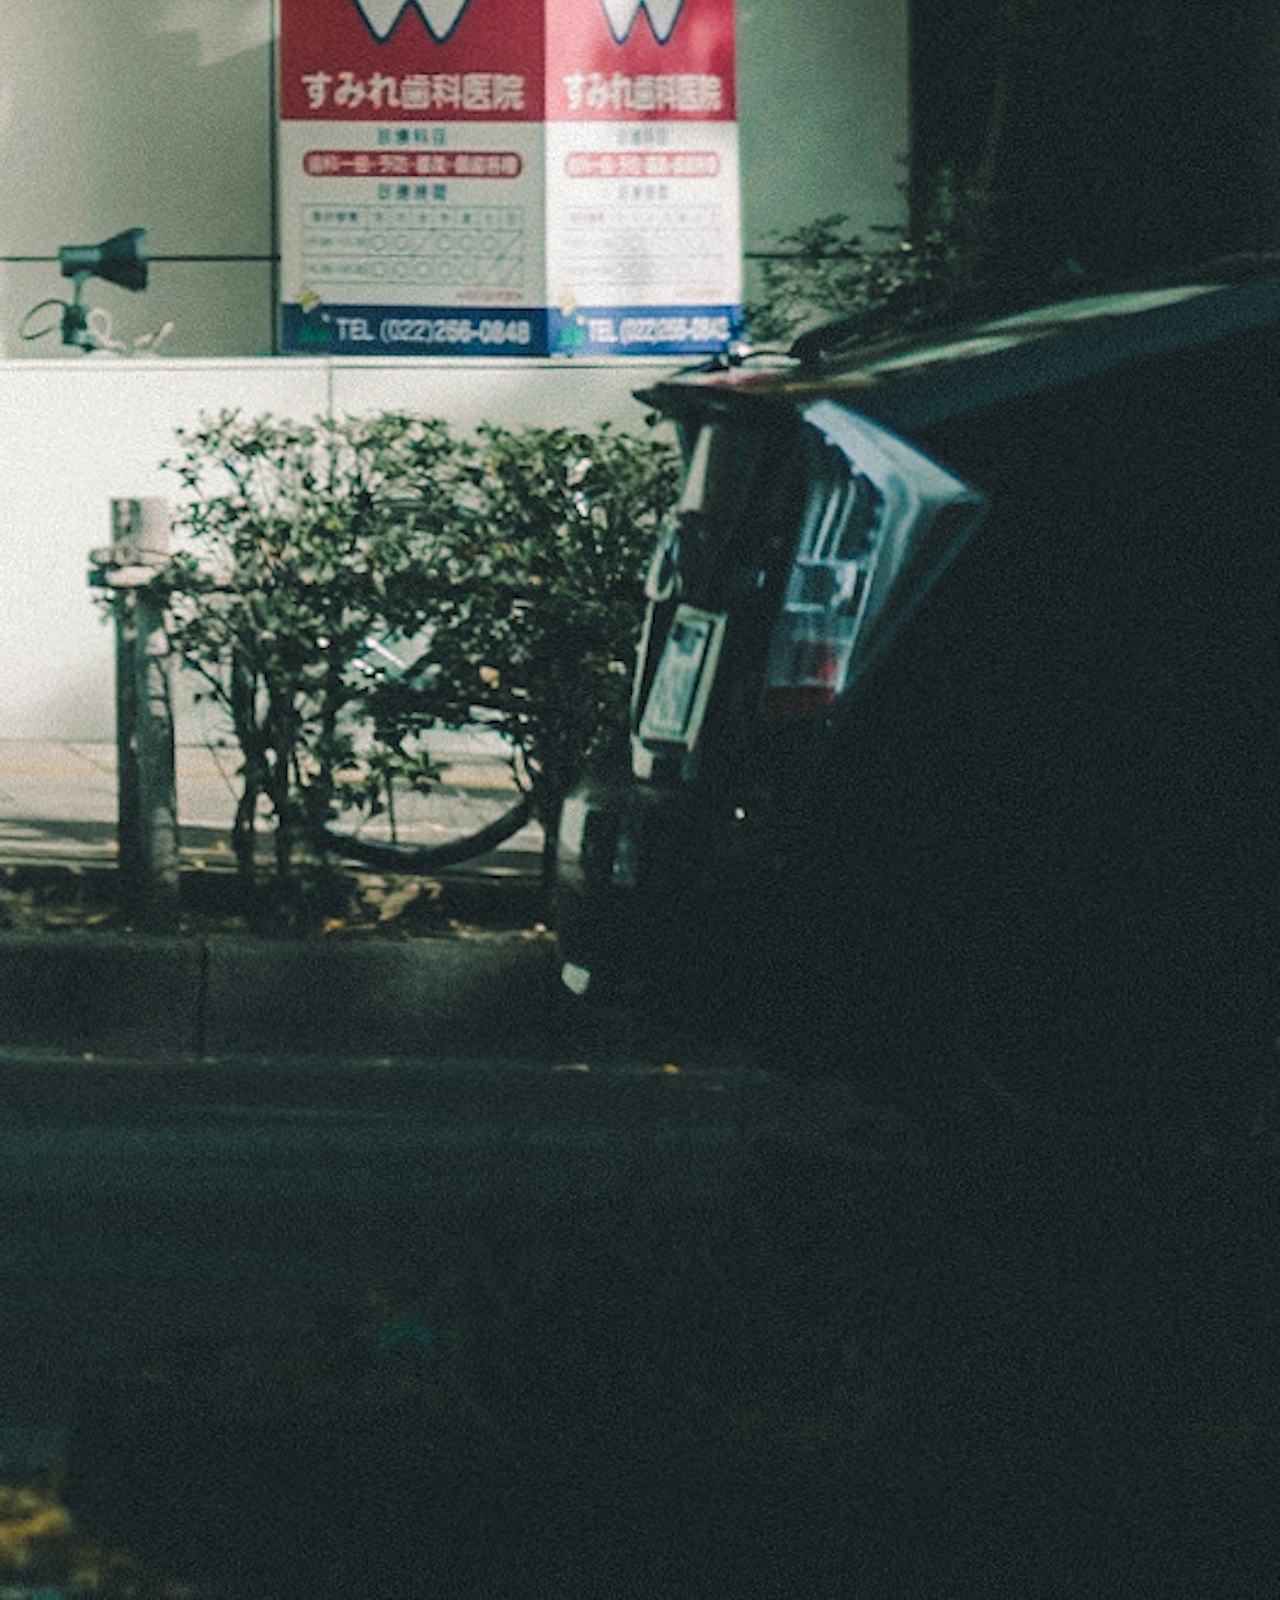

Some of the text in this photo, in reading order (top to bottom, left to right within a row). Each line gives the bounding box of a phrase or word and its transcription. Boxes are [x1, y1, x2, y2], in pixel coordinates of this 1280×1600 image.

[301, 71, 525, 111] すみれ歯科医院
[562, 71, 723, 112] すみれ歯科医院
[335, 318, 376, 342] TEL
